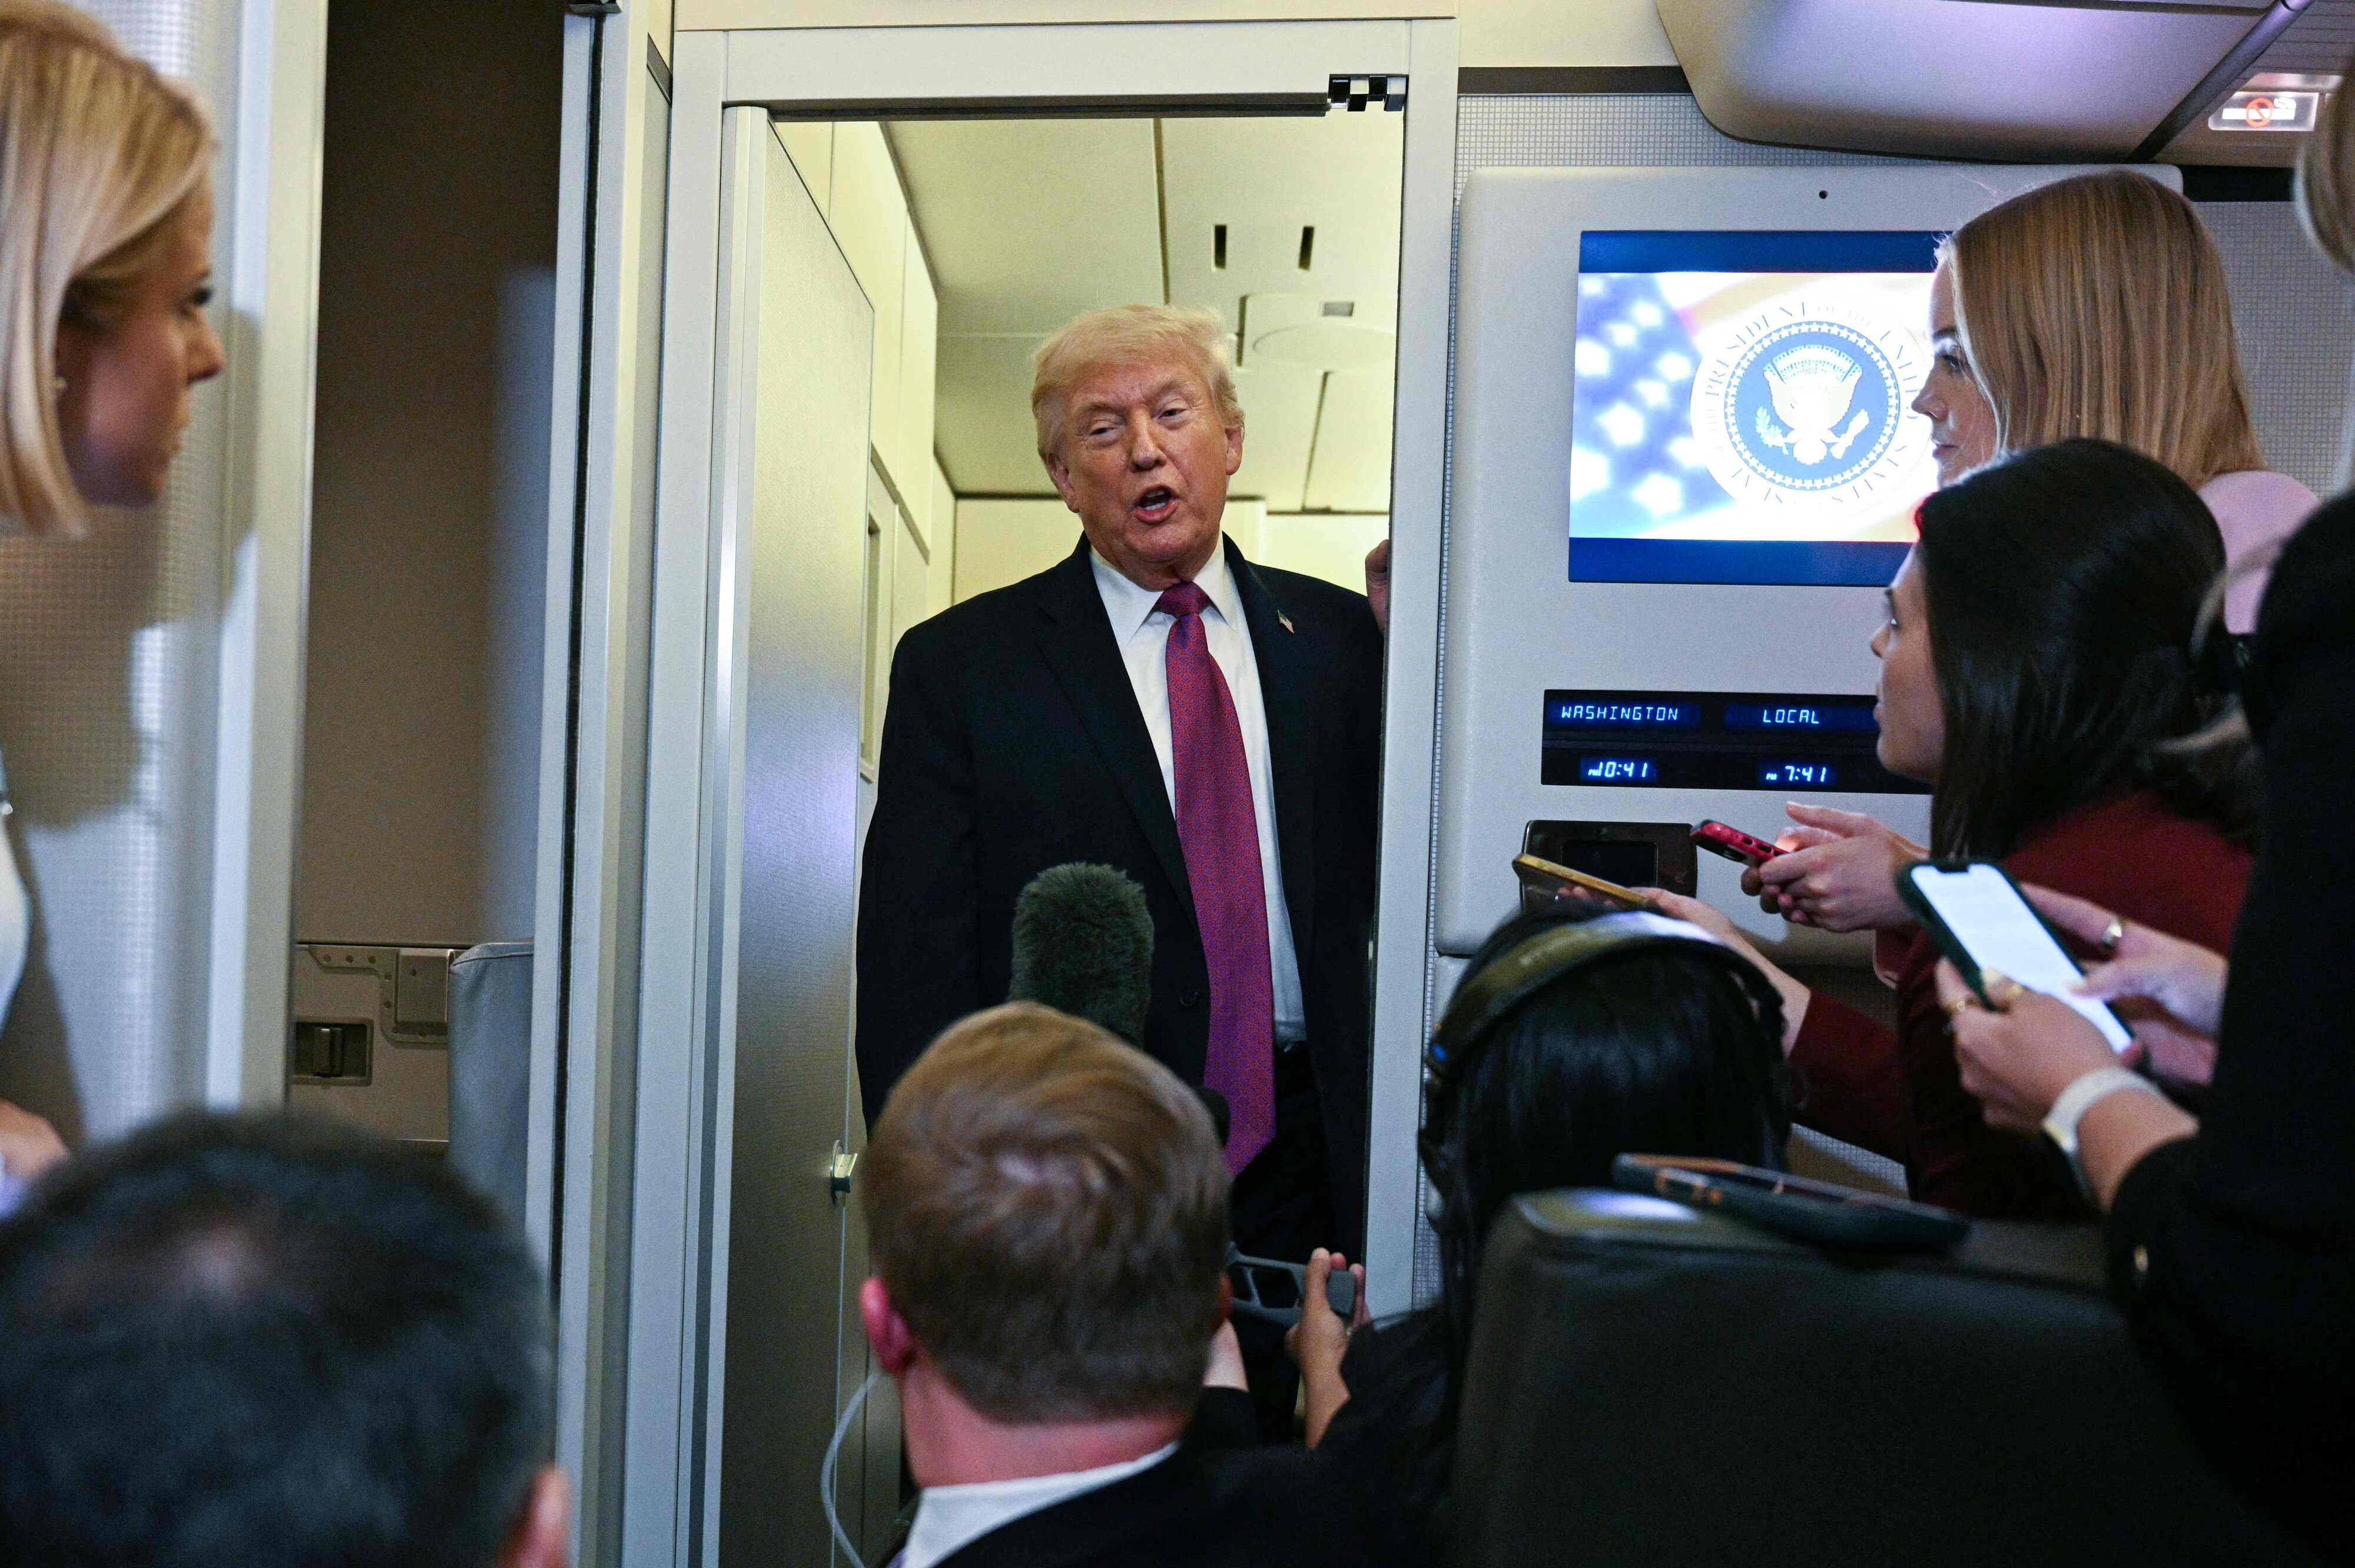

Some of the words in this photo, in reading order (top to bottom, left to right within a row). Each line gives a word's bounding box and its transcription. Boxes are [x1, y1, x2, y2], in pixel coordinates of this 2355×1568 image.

[1561, 706, 1678, 720] WASHINGTON
[1763, 709, 1819, 724] LOCAL
[1597, 762, 1648, 778] 10:41
[1785, 766, 1826, 782] 7:41
